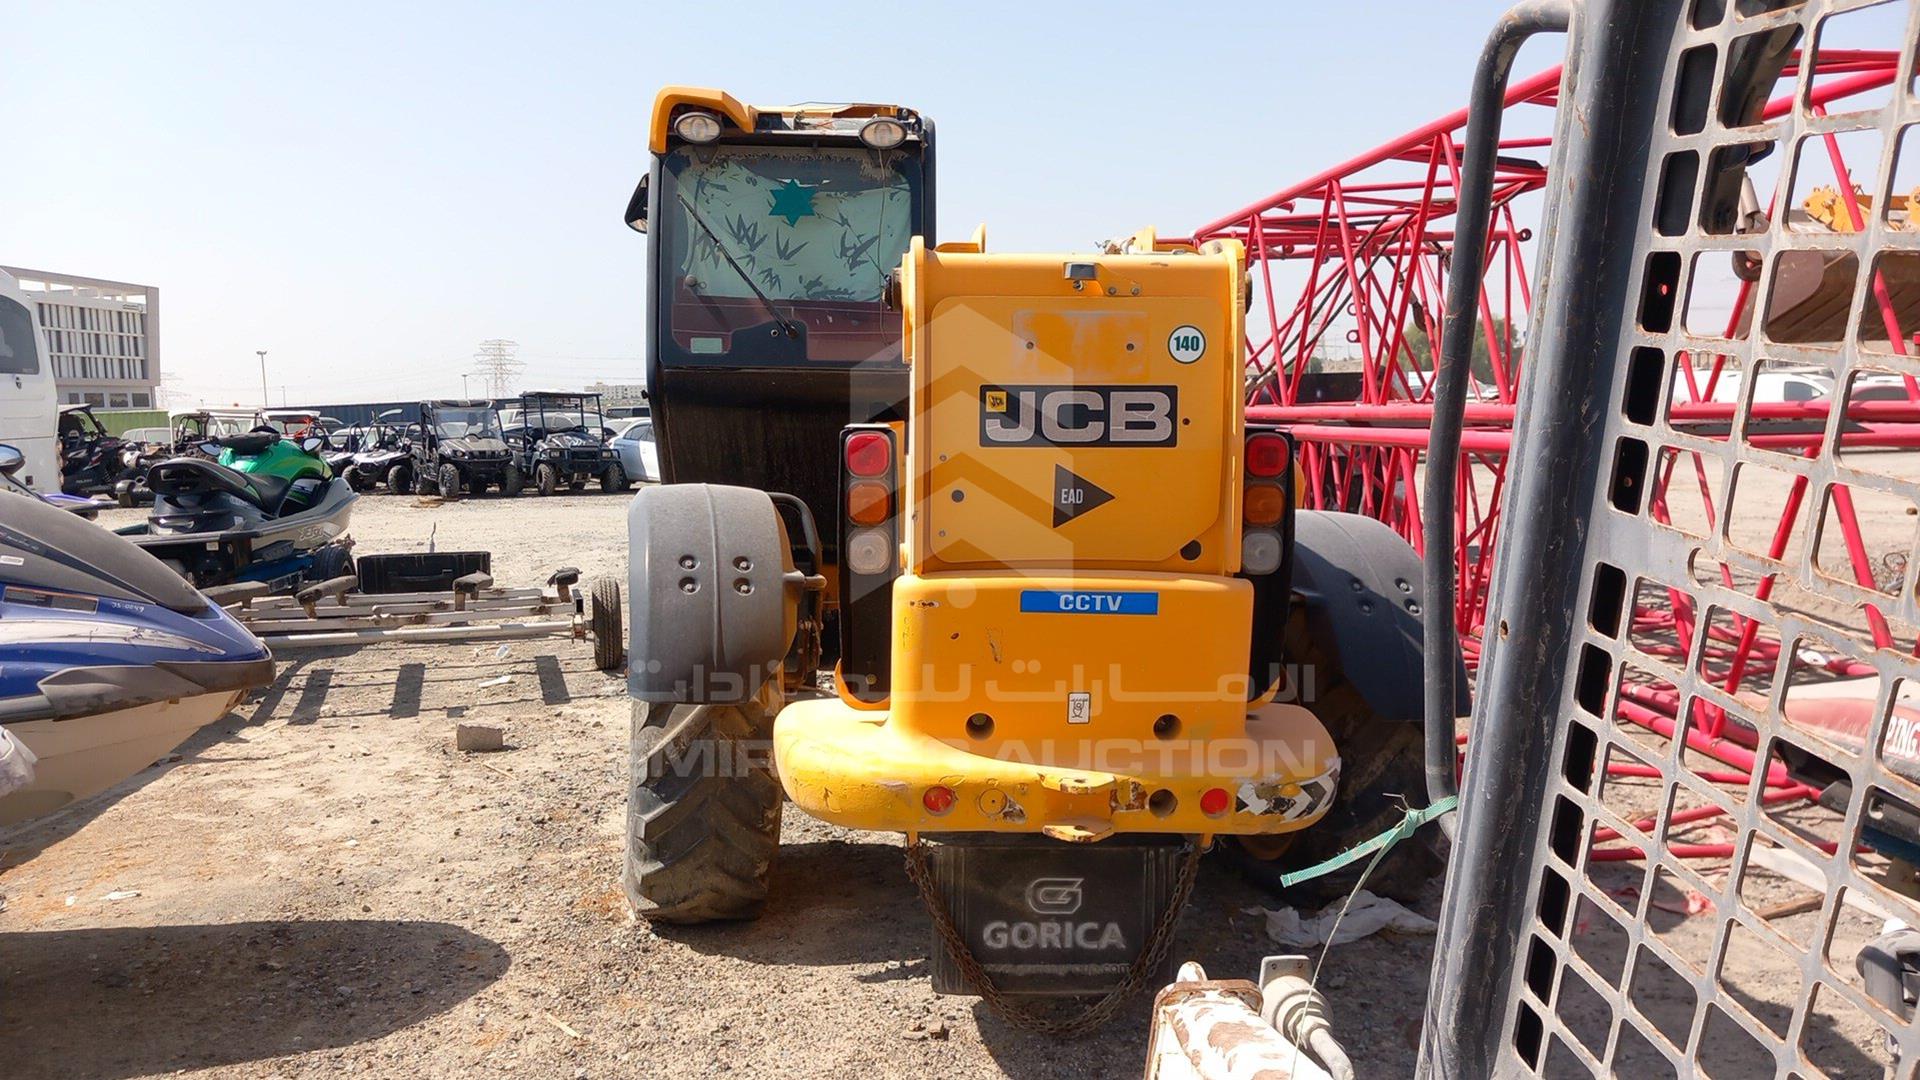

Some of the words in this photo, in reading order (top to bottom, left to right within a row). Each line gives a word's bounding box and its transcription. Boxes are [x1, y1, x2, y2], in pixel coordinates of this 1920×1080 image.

[1174, 335, 1200, 352] 140
[985, 390, 1173, 443] JCB
[1061, 488, 1084, 505] EAD
[1059, 594, 1122, 611] CCTV
[983, 921, 1127, 949] GORICA
